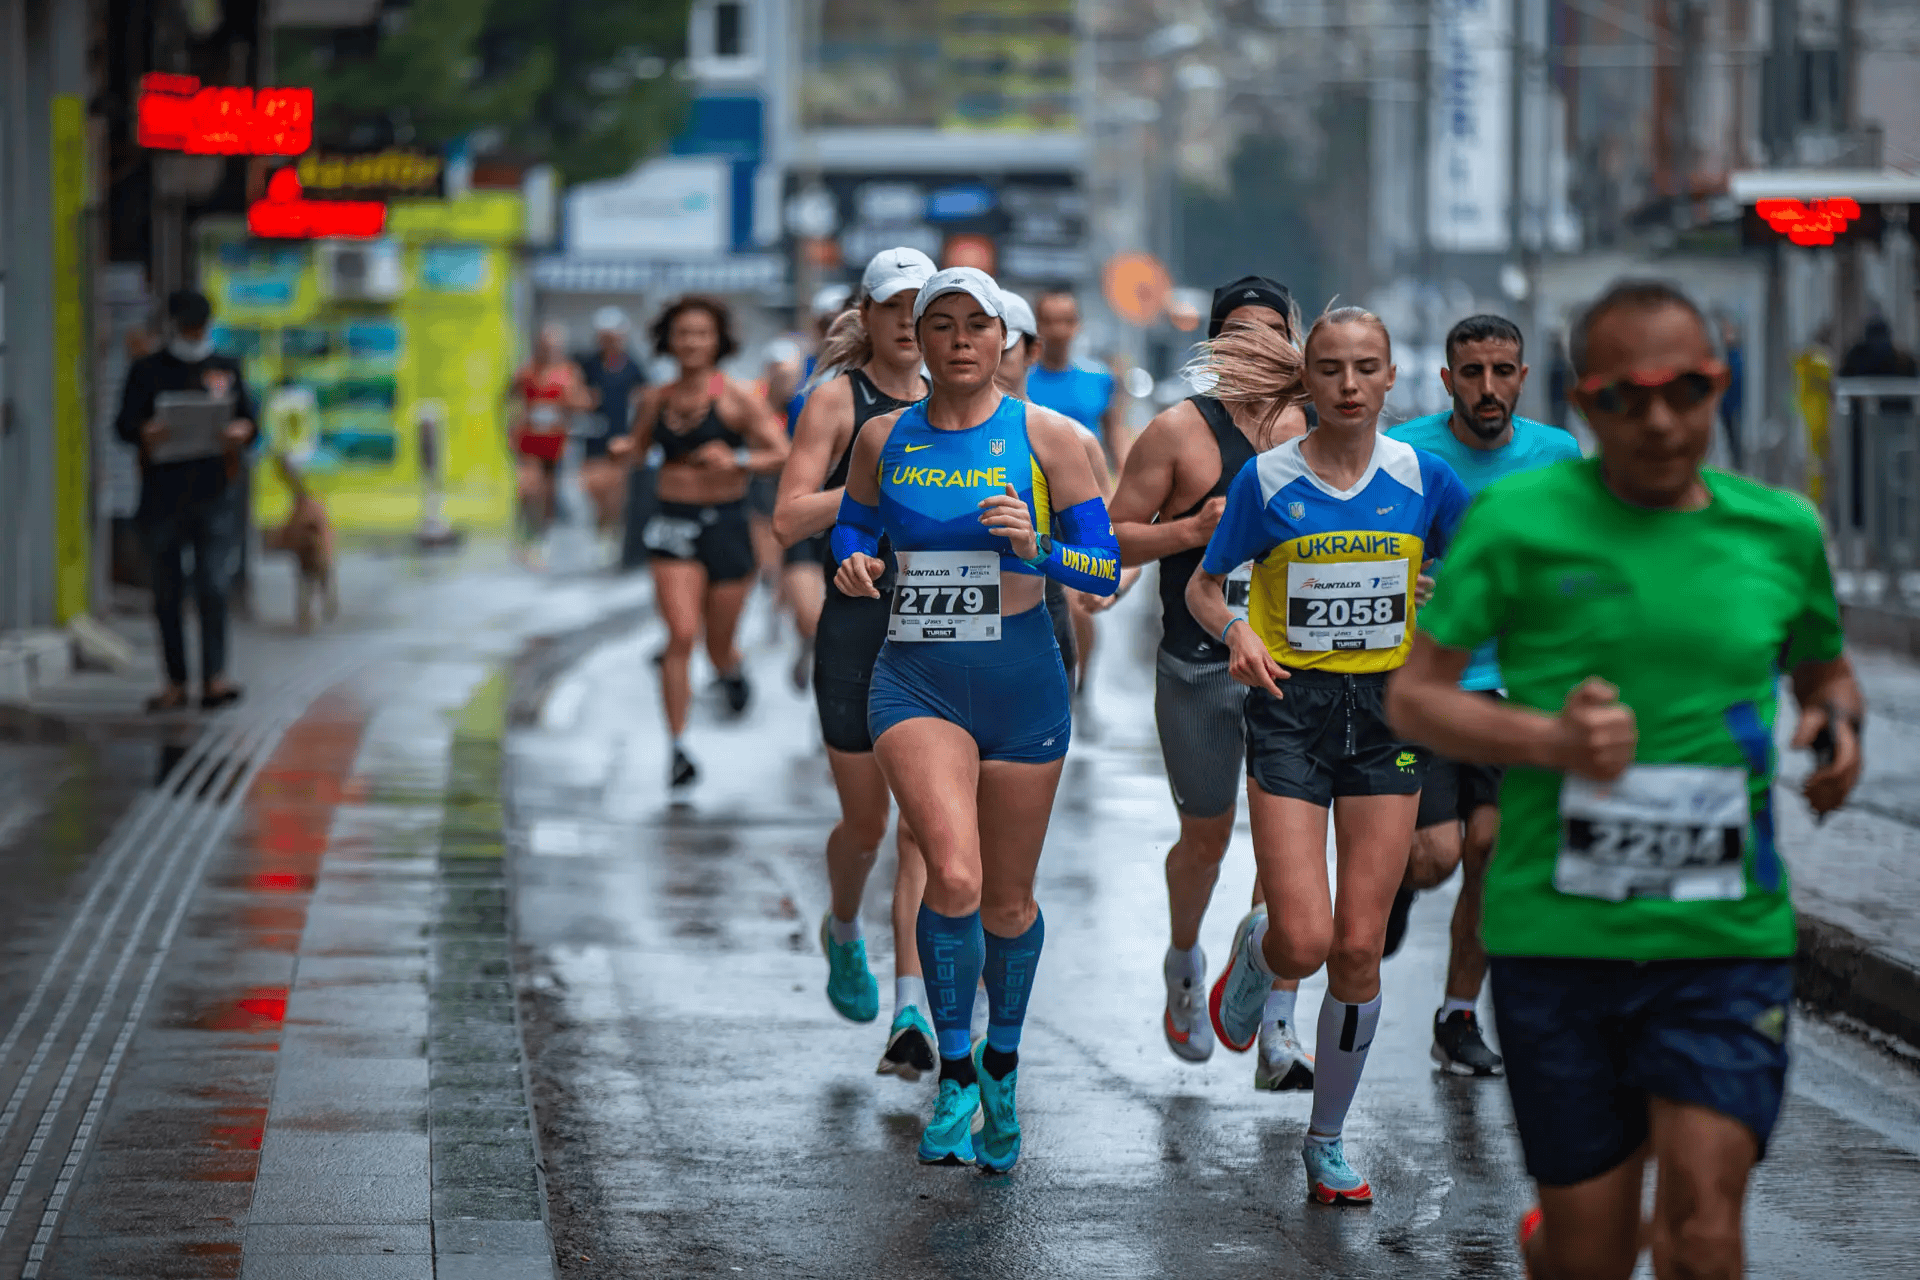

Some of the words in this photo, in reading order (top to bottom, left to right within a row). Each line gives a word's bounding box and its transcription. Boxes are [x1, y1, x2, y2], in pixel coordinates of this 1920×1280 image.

[892, 466, 1007, 487] UKRAINE
[1297, 535, 1401, 559] UKRAINE
[905, 569, 950, 577] RUNTALYA
[1062, 547, 1117, 581] UKRAINE
[1313, 581, 1361, 590] RUNTALYA
[899, 586, 984, 614] 2779
[1306, 597, 1393, 626] 2058
